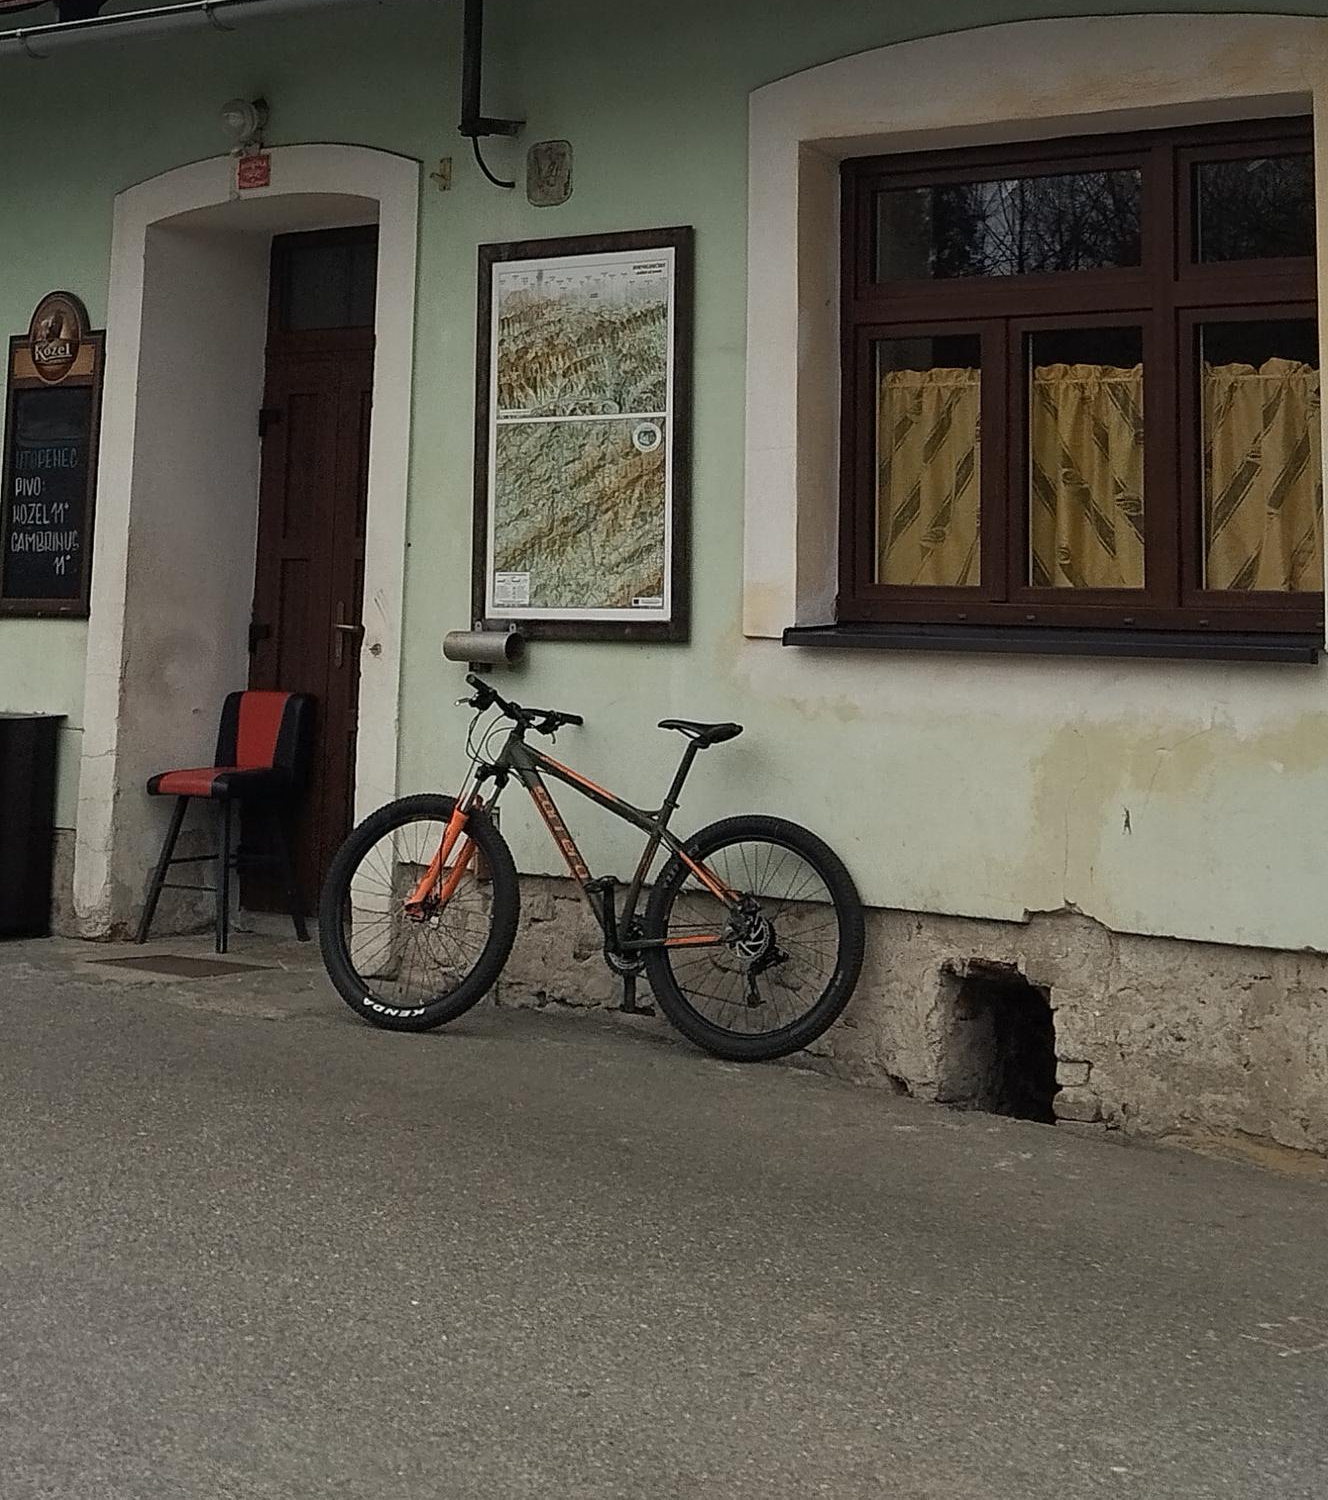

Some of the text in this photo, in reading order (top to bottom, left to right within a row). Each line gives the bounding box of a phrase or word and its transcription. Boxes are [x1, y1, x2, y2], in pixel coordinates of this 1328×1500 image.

[34, 341, 72, 361] Kozel
[12, 503, 50, 525] KOZEL
[11, 530, 80, 552] GAMBRINUS
[363, 997, 426, 1017] KENDA
